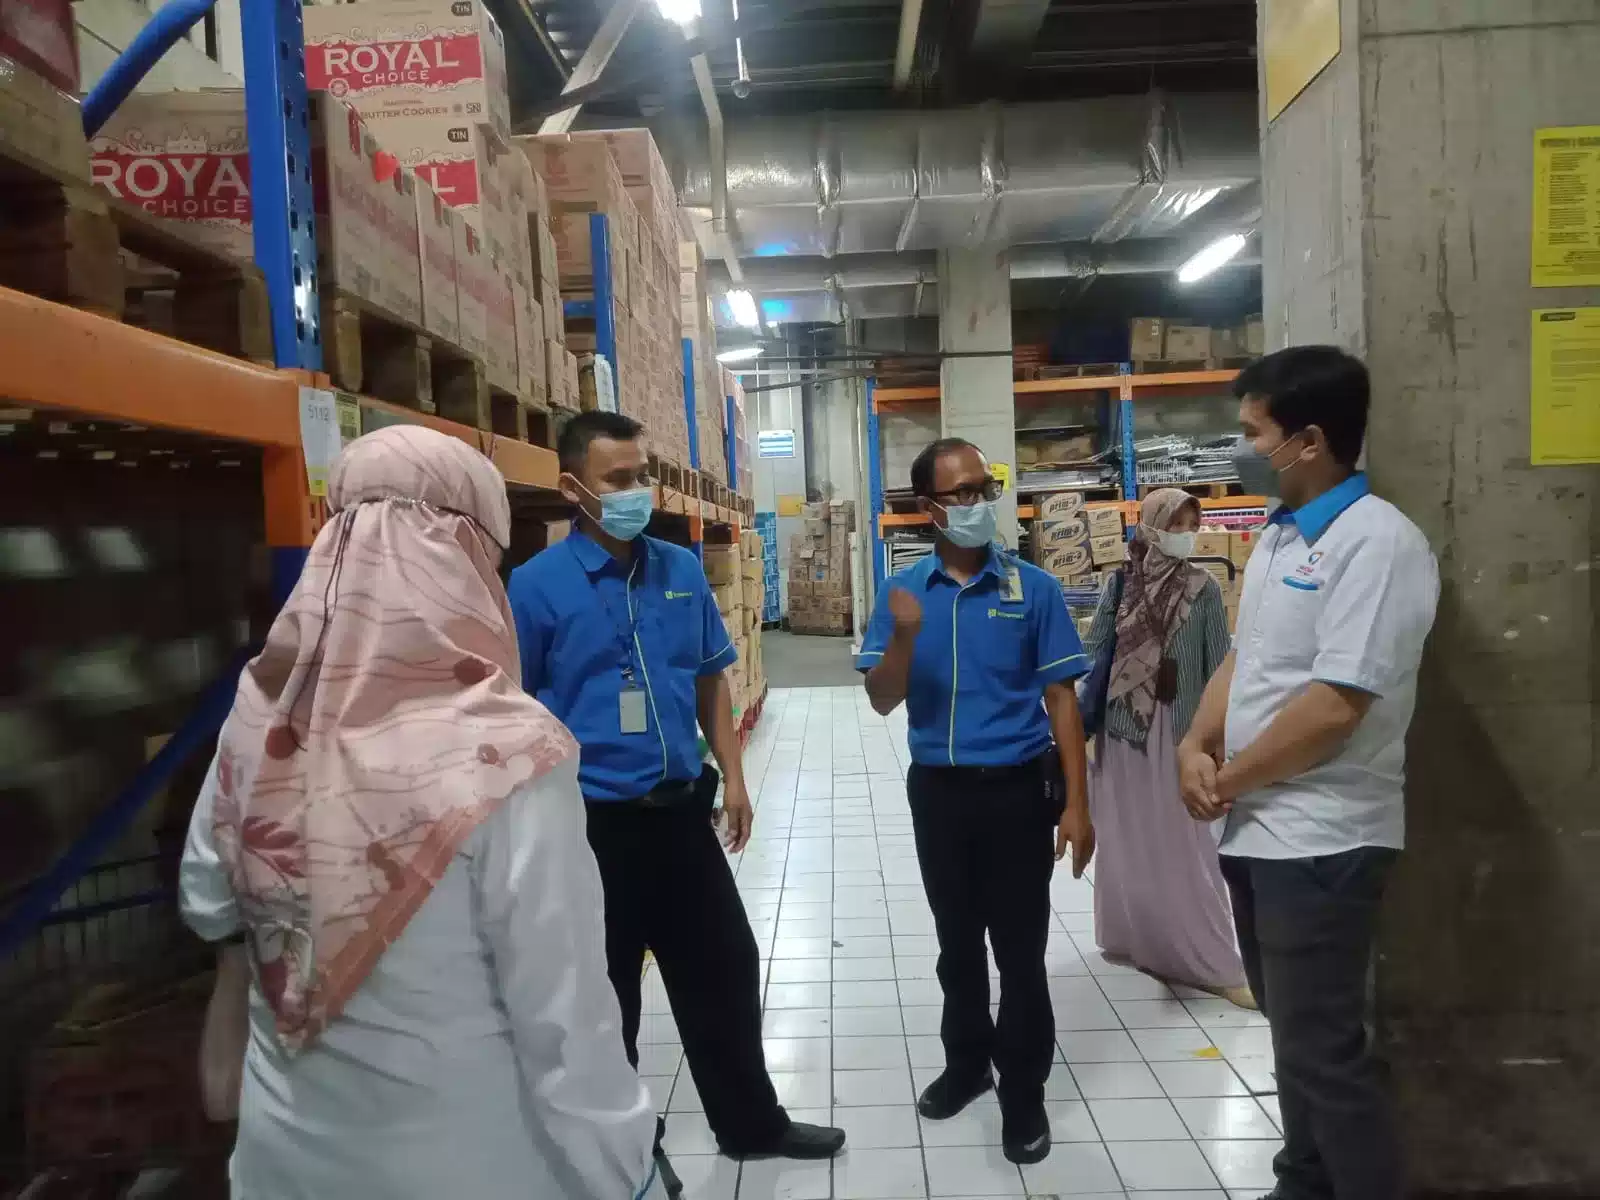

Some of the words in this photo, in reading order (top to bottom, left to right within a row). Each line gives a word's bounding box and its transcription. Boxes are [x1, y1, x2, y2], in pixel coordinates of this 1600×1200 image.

[324, 41, 460, 76] ROYAL
[362, 70, 430, 84] CHOICE
[452, 129, 468, 140] TIN
[89, 157, 250, 198] ROYA
[142, 199, 248, 215] CHOICE
